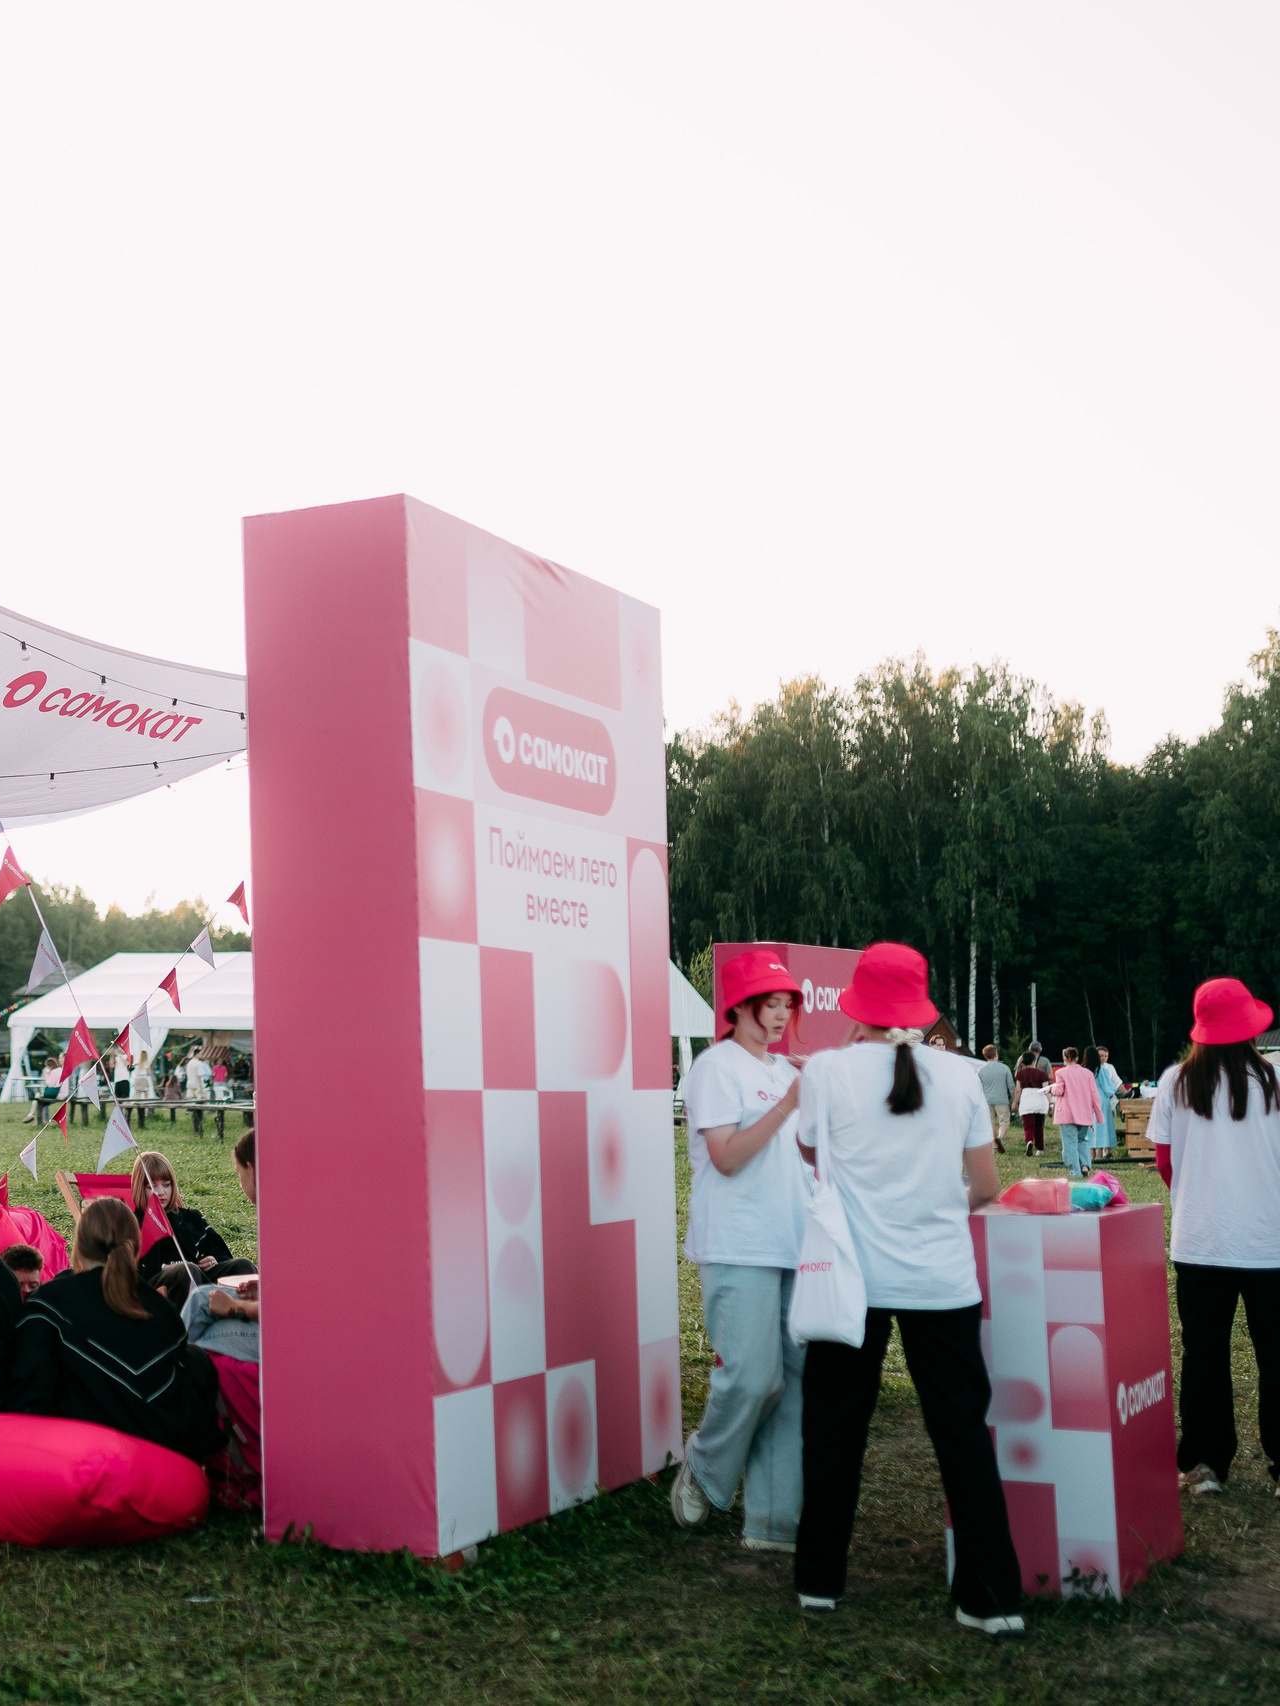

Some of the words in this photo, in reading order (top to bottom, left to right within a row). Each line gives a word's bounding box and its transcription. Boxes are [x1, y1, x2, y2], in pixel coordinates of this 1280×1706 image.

[38, 687, 203, 743] самокат
[519, 732, 609, 786] самокат
[488, 826, 577, 881] Поймаем
[579, 855, 618, 889] лето
[526, 893, 589, 929] вместе
[1128, 1370, 1166, 1417] самокат
